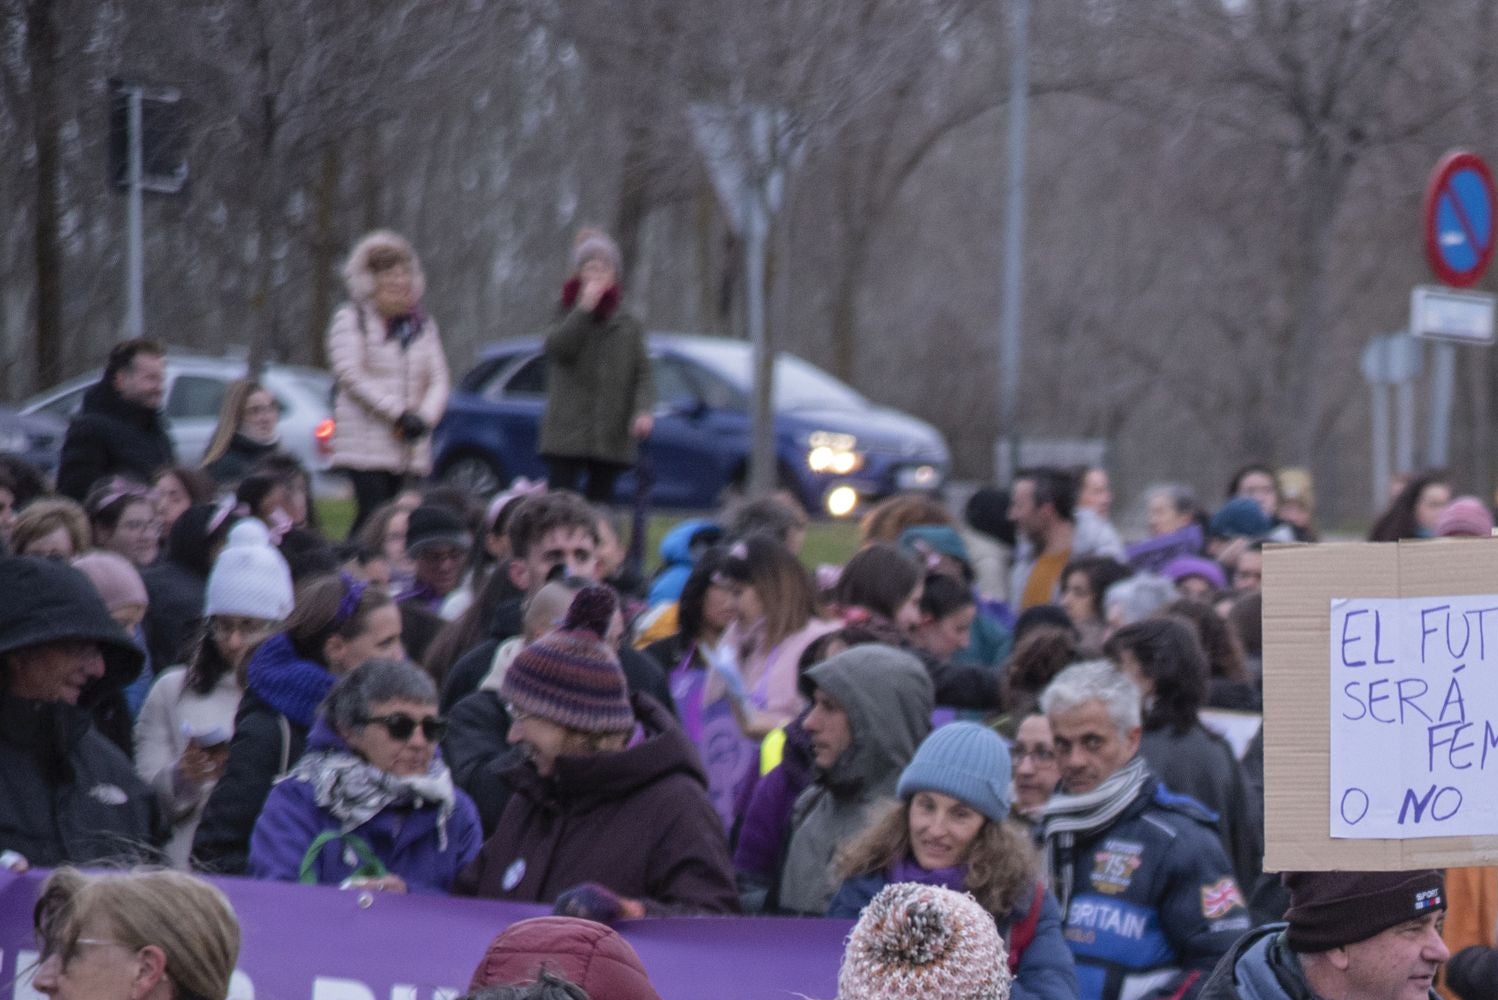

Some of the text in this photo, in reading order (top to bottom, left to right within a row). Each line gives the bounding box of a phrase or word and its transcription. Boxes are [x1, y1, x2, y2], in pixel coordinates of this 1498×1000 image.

[1341, 608, 1396, 668] EL
[1342, 664, 1467, 725] SERÁ
[1340, 787, 1370, 826] O
[1397, 784, 1464, 825] NO
